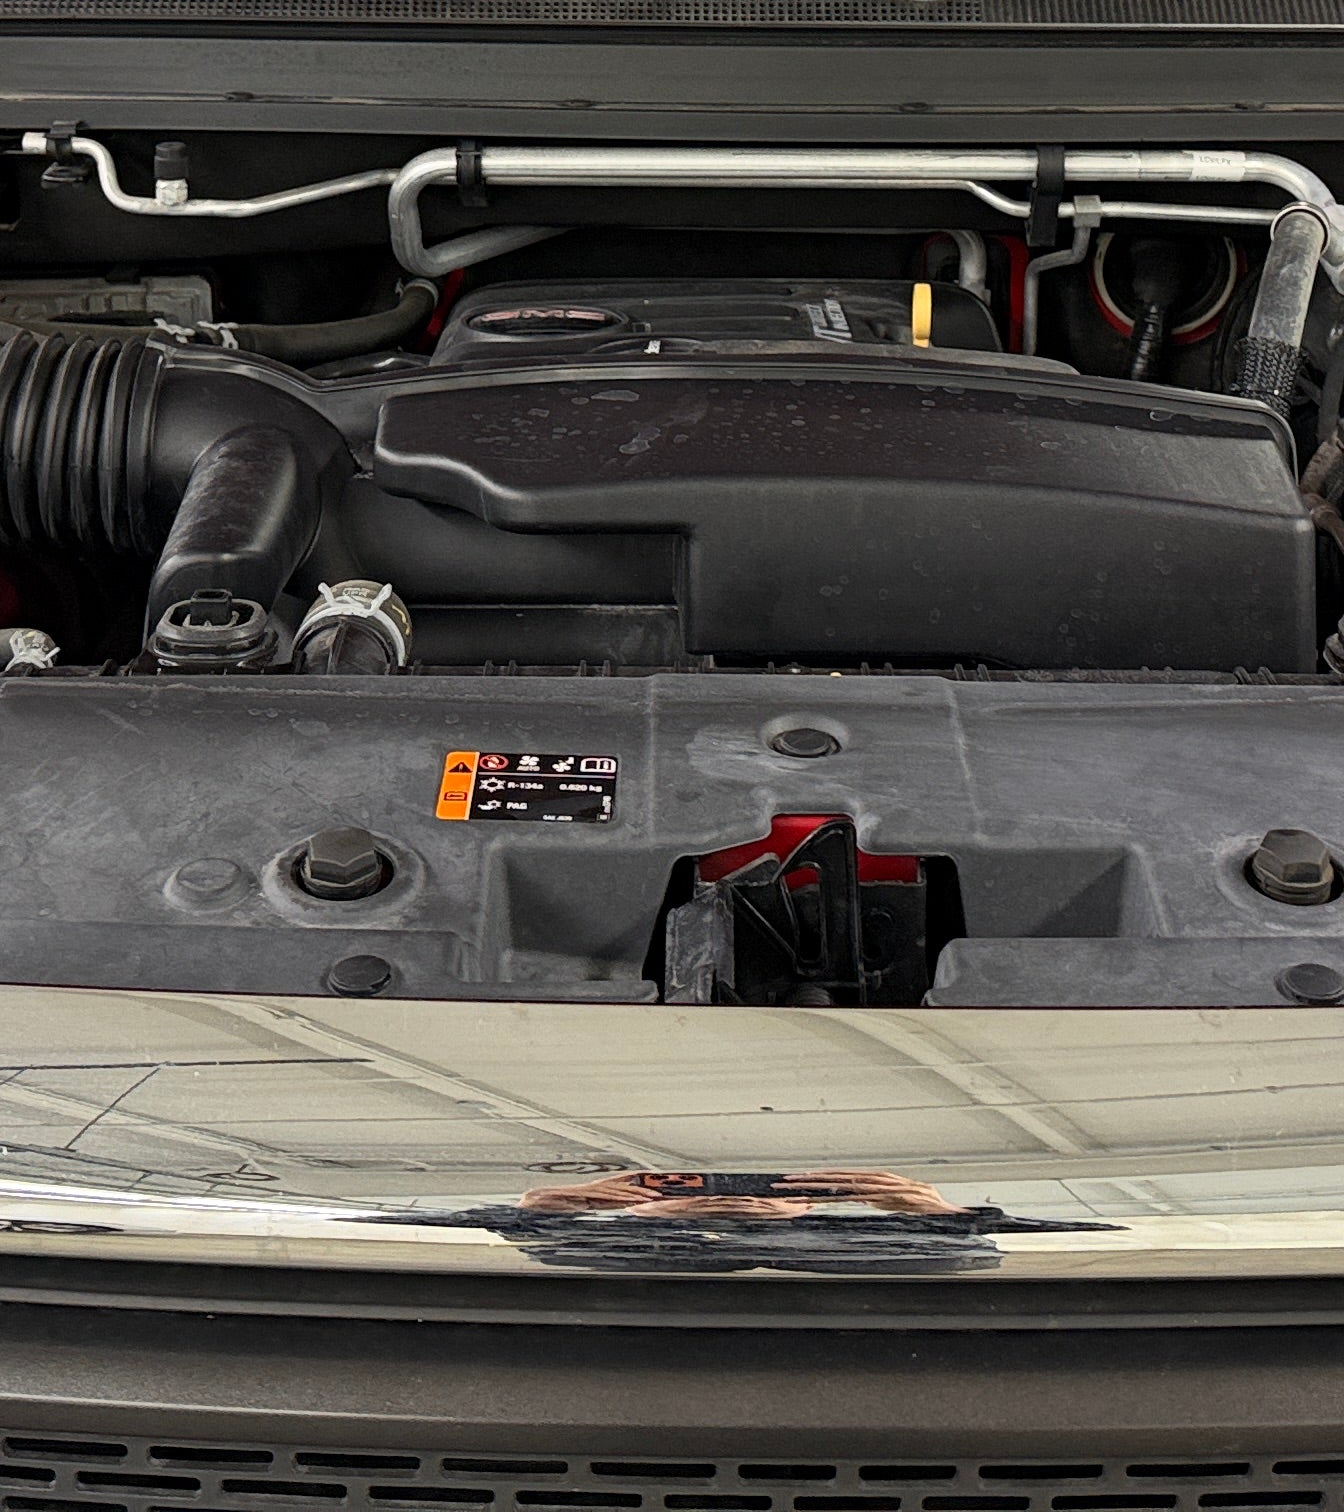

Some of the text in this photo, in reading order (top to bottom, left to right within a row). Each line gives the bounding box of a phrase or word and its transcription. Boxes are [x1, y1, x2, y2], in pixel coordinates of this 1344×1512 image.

[507, 782, 544, 791] R-134a
[588, 784, 603, 793] kg
[506, 801, 528, 810] PAG
